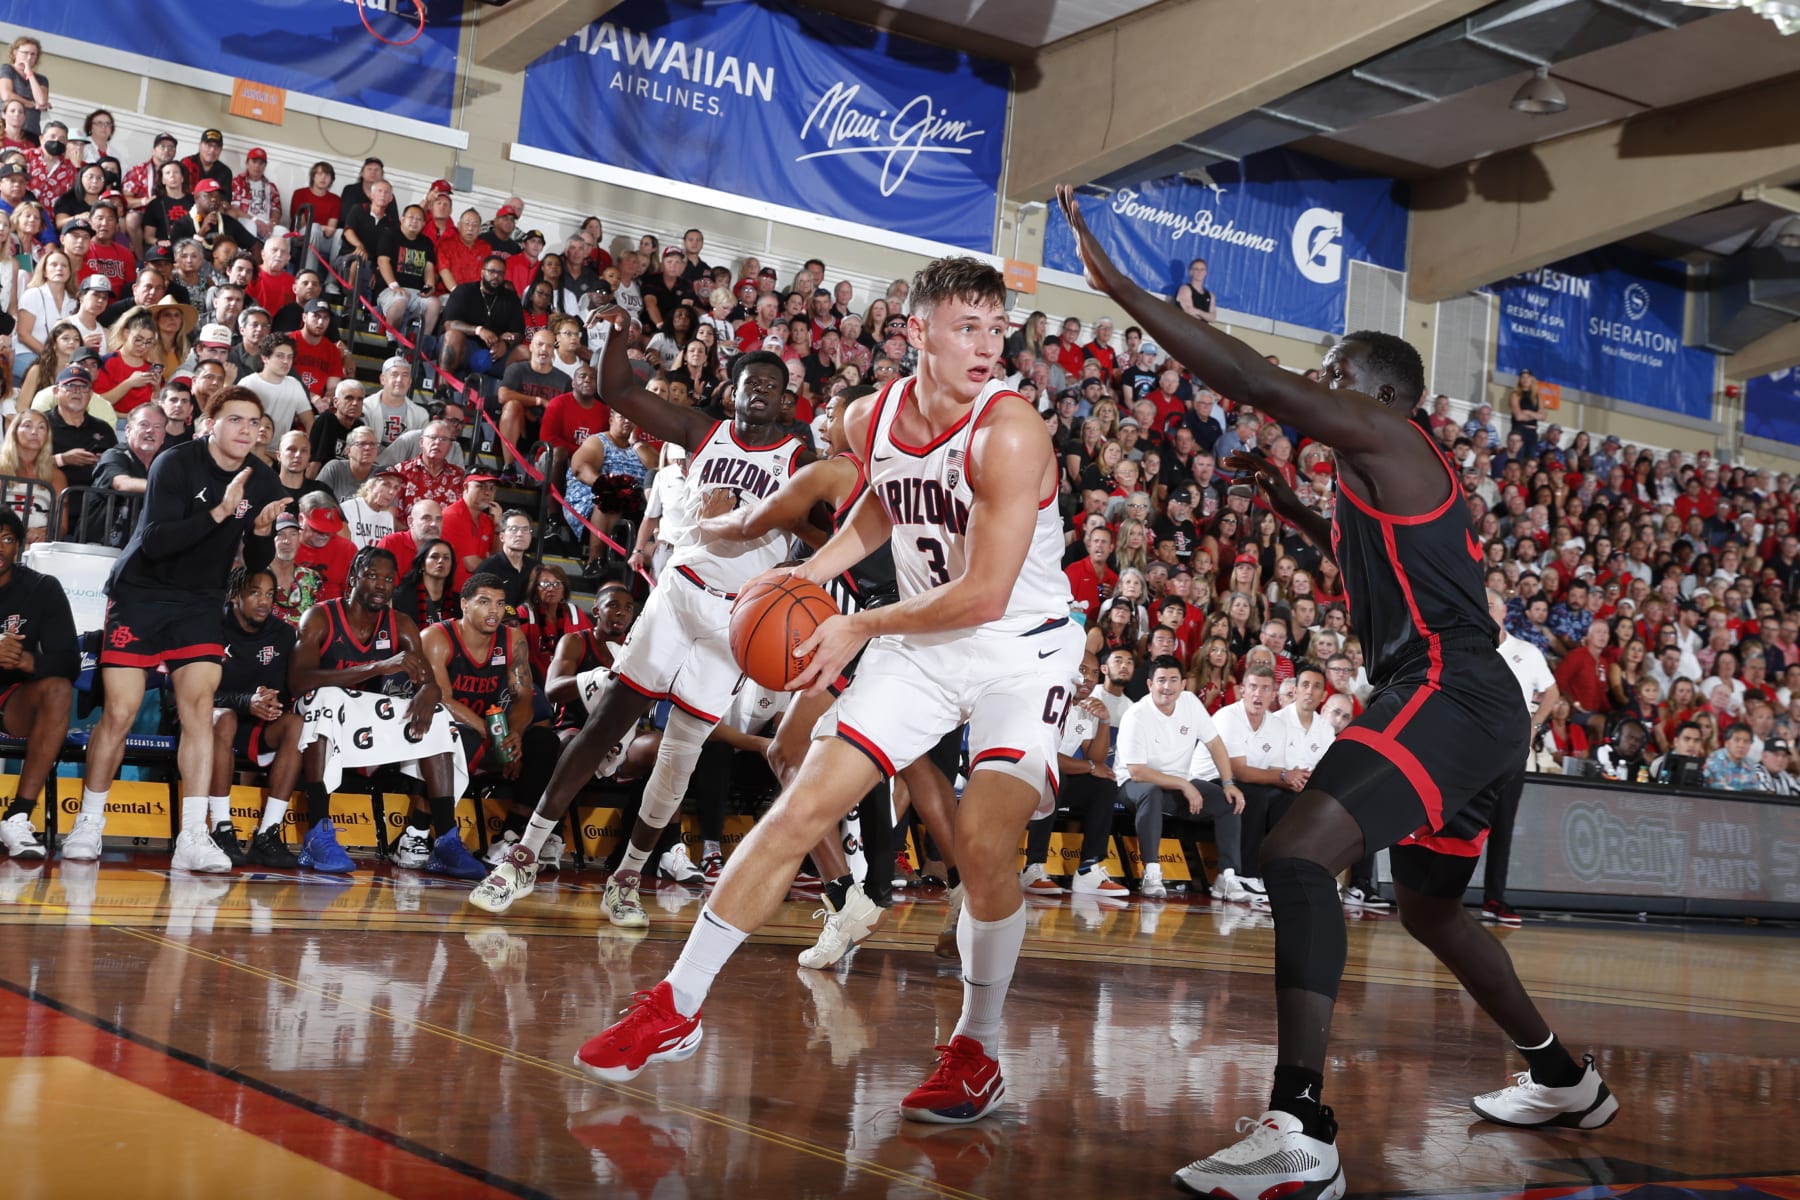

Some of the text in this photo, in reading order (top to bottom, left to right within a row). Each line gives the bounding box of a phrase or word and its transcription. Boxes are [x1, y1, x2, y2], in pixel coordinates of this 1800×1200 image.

[609, 71, 720, 116] AIRLINES
[800, 81, 986, 197] Maui Jim
[1112, 187, 1275, 253] Tommy Bahama
[1588, 316, 1678, 354] SHERATON
[356, 521, 372, 537] SAN
[916, 537, 951, 588] 3
[452, 673, 499, 693] AZTECS
[375, 698, 395, 721] G
[353, 726, 374, 750] G
[61, 797, 152, 815] Conental
[1697, 819, 1751, 854] AUTO
[1692, 855, 1762, 891] PARTS
